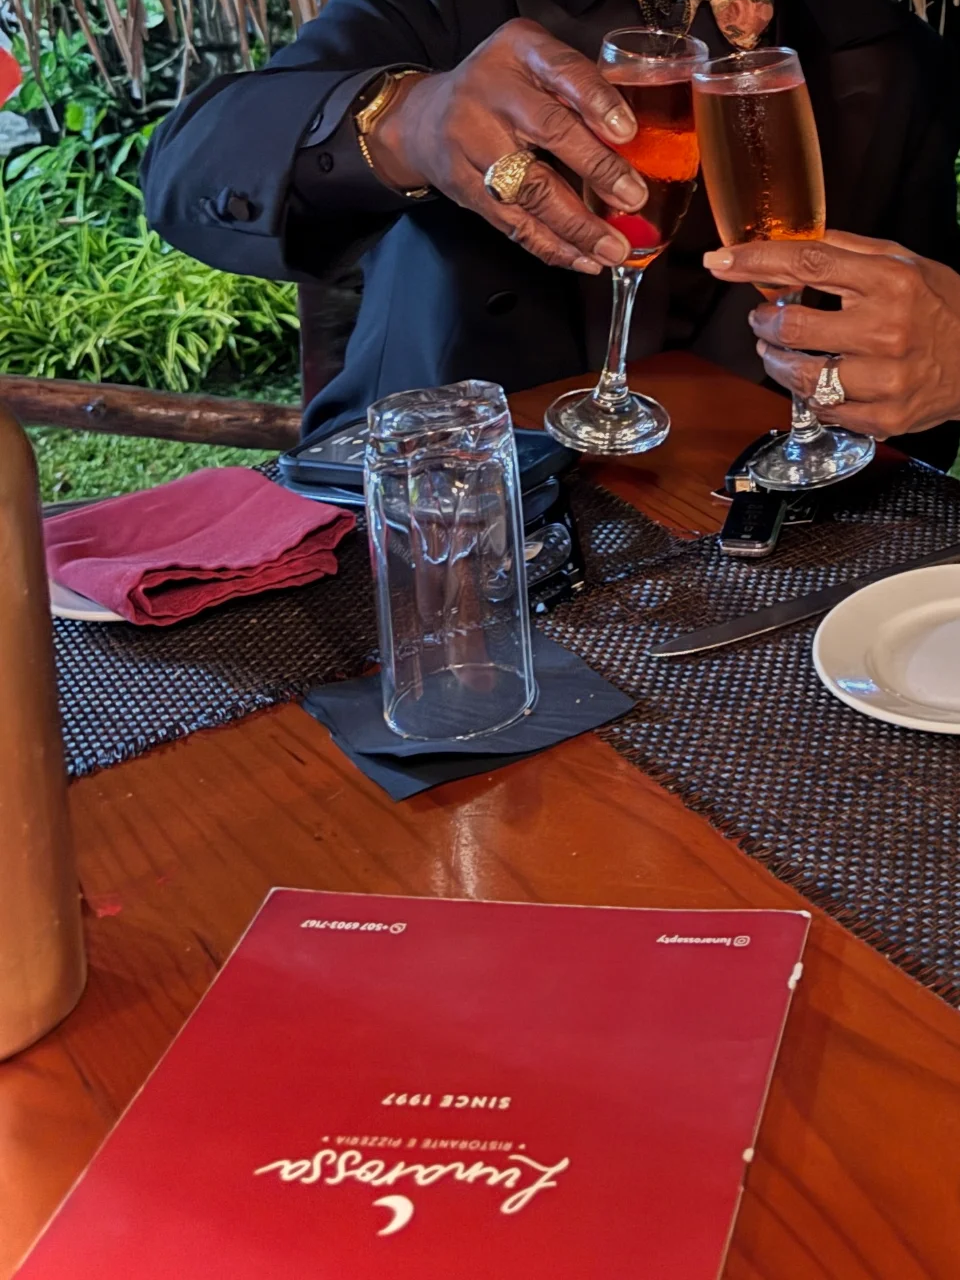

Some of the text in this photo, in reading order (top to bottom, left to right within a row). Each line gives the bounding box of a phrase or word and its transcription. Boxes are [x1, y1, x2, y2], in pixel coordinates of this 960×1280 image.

[360, 922, 389, 932] +507
[655, 933, 732, 947] lunarossapty
[381, 1092, 512, 1110] SINCE 1997
[336, 1134, 514, 1152] RISTORANTE E PIZZERIA
[253, 1148, 570, 1215] Lunarossa
